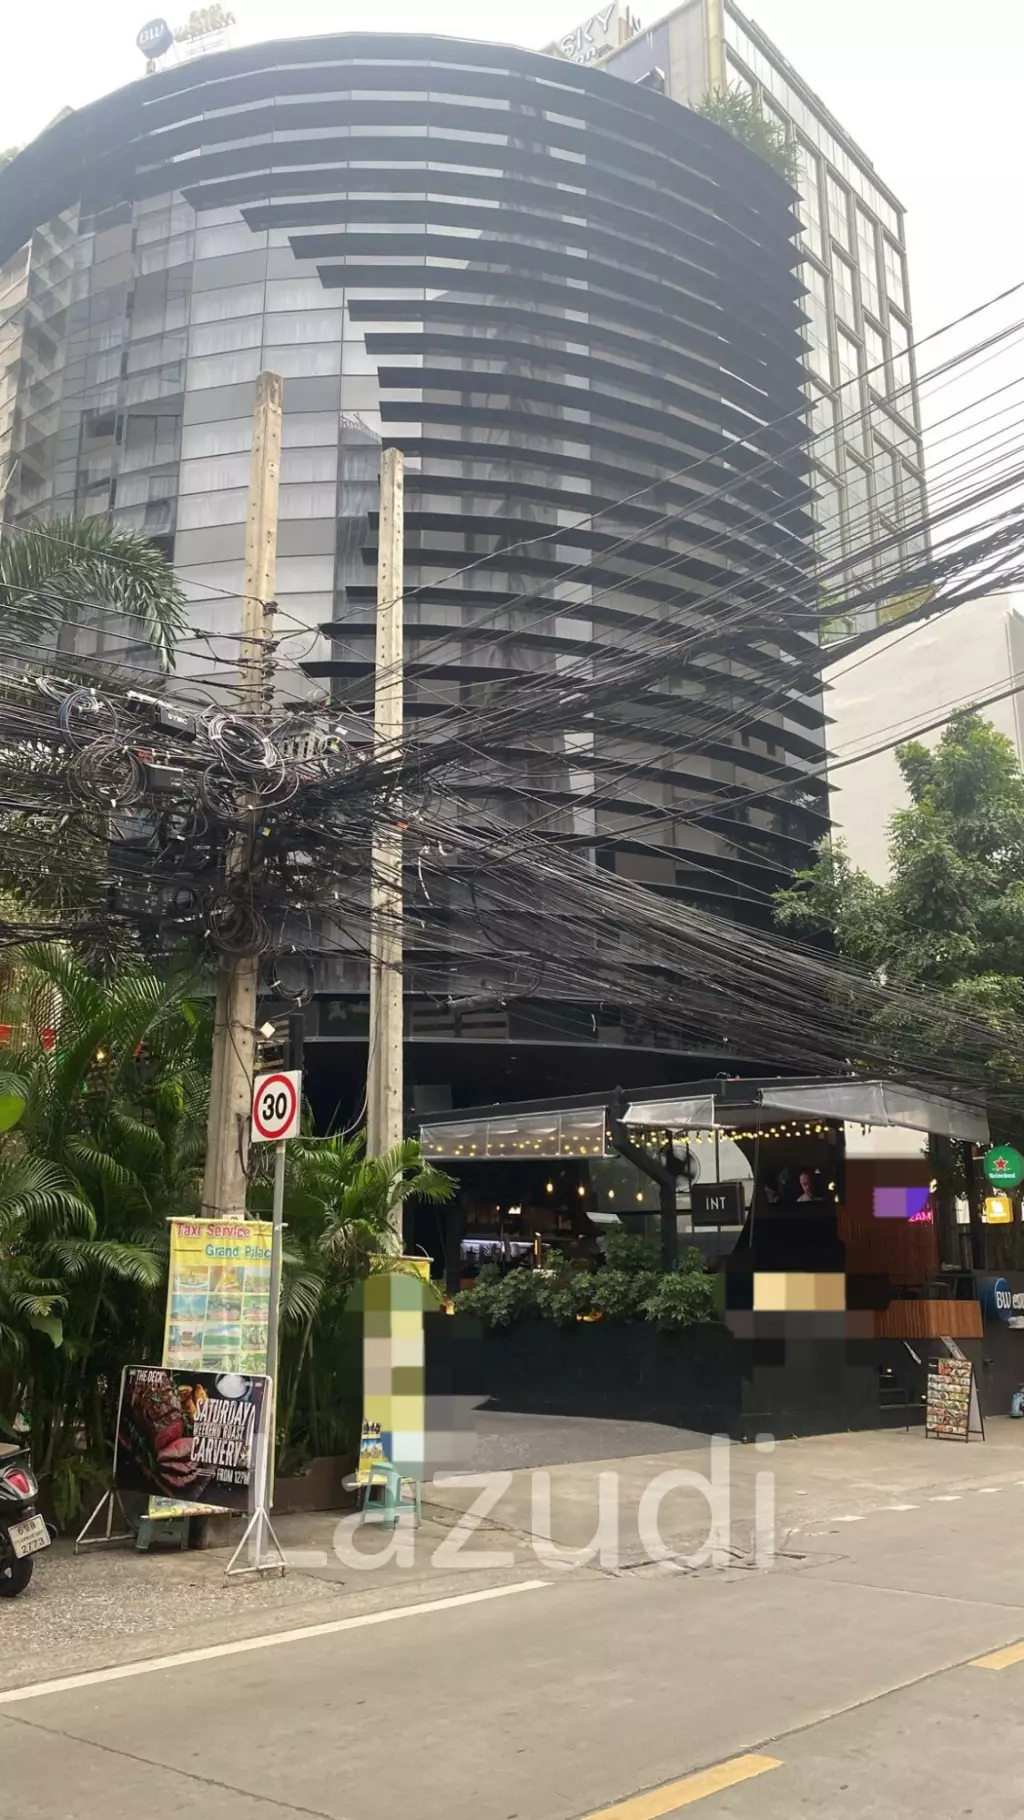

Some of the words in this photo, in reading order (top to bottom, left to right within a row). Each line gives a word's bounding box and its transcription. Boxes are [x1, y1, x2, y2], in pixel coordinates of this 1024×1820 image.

[140, 23, 165, 45] BW
[560, 3, 616, 57] SKY
[263, 1092, 287, 1120] 30
[176, 1223, 201, 1237] Taxi
[206, 1223, 250, 1238] Service
[205, 1243, 239, 1258] Grand
[244, 1245, 273, 1259] Palac
[996, 1290, 1012, 1309] BW
[136, 1370, 148, 1382] THE
[193, 1397, 252, 1426] SATURDAY
[193, 1421, 222, 1438] WEEKEND
[222, 1425, 245, 1441] ROAST
[190, 1436, 243, 1467] CARVERY
[216, 1468, 234, 1483] FROM
[234, 1471, 250, 1485] 12PM
[20, 1537, 45, 1554] 2773
